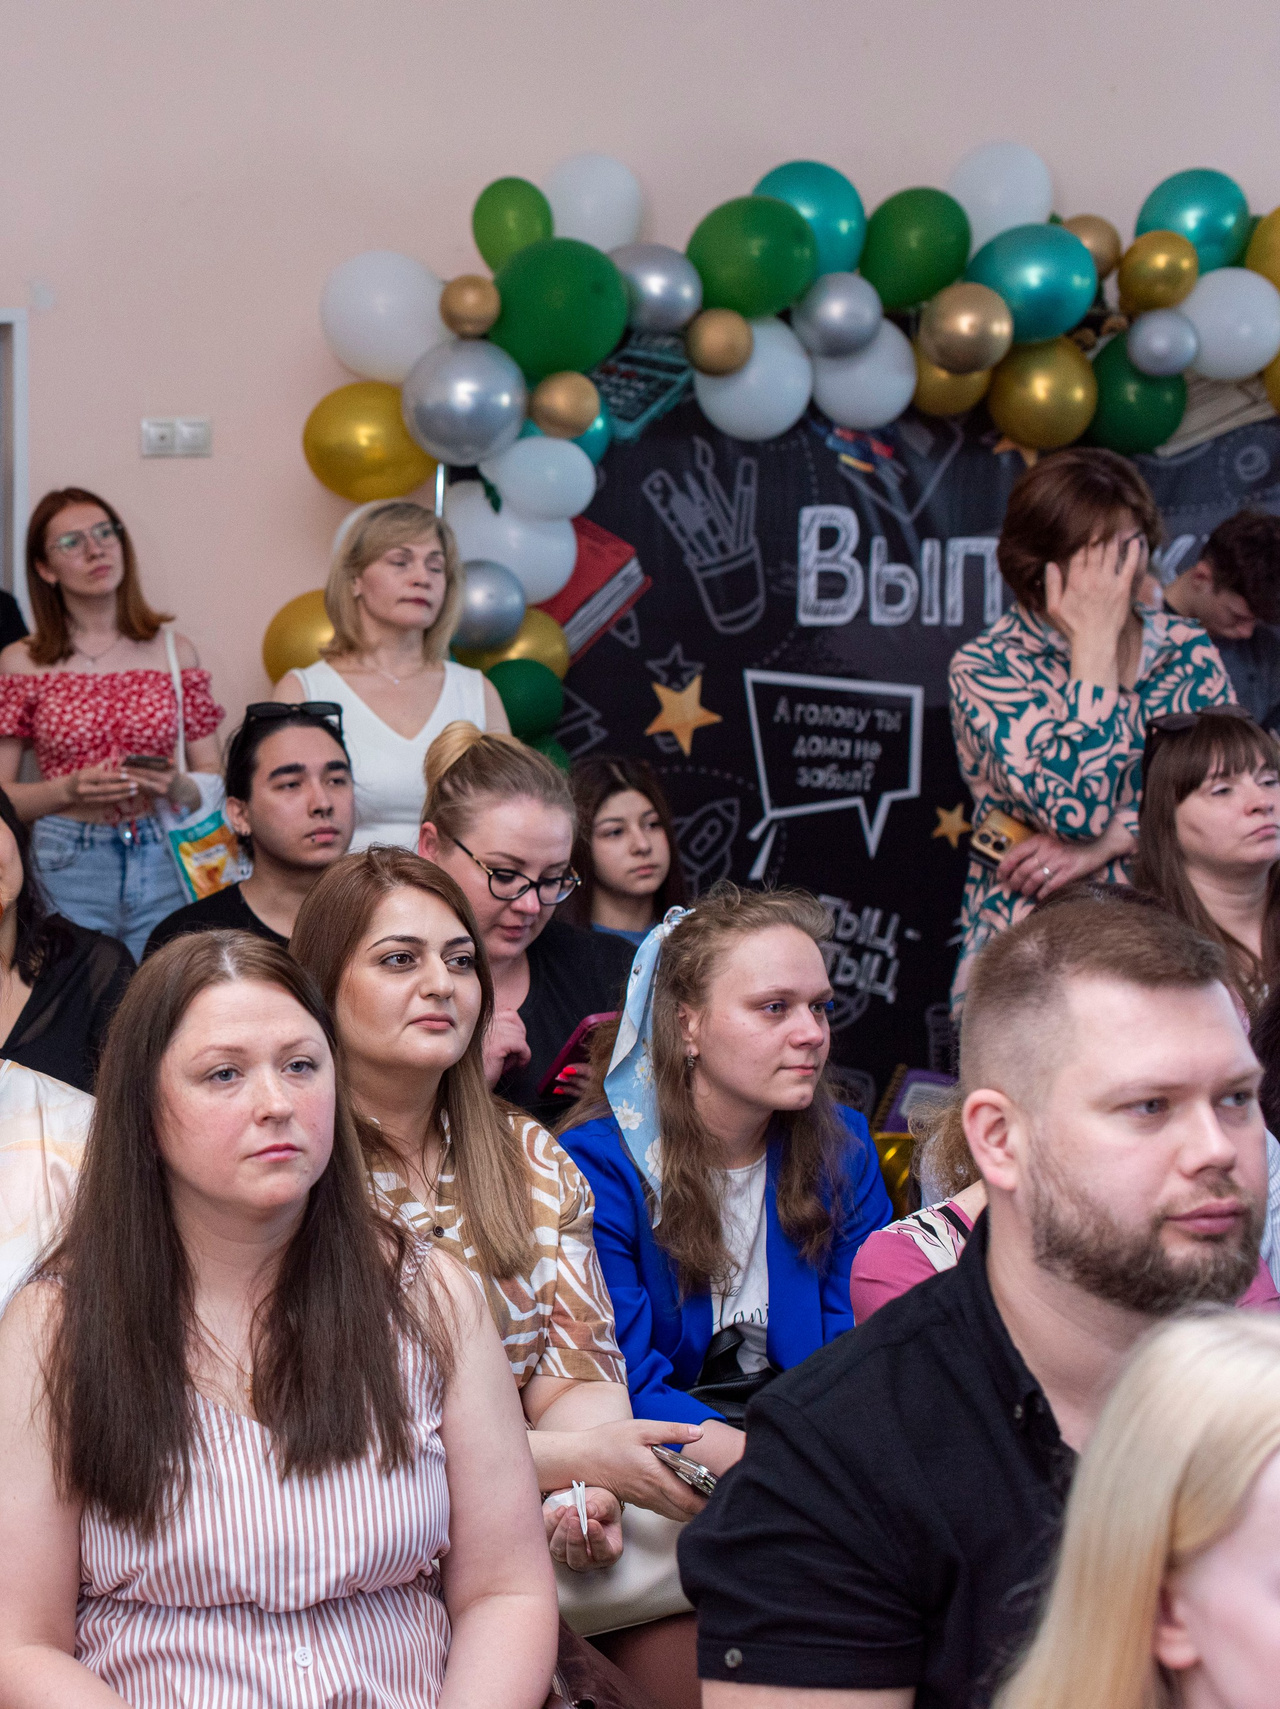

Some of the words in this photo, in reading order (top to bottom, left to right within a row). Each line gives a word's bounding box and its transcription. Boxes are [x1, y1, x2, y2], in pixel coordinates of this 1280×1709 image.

[797, 504, 1003, 626] Вып
[773, 696, 791, 723] А
[794, 703, 870, 733] голову
[792, 735, 852, 758] дома
[854, 738, 882, 760] не
[796, 761, 875, 792] забыл?
